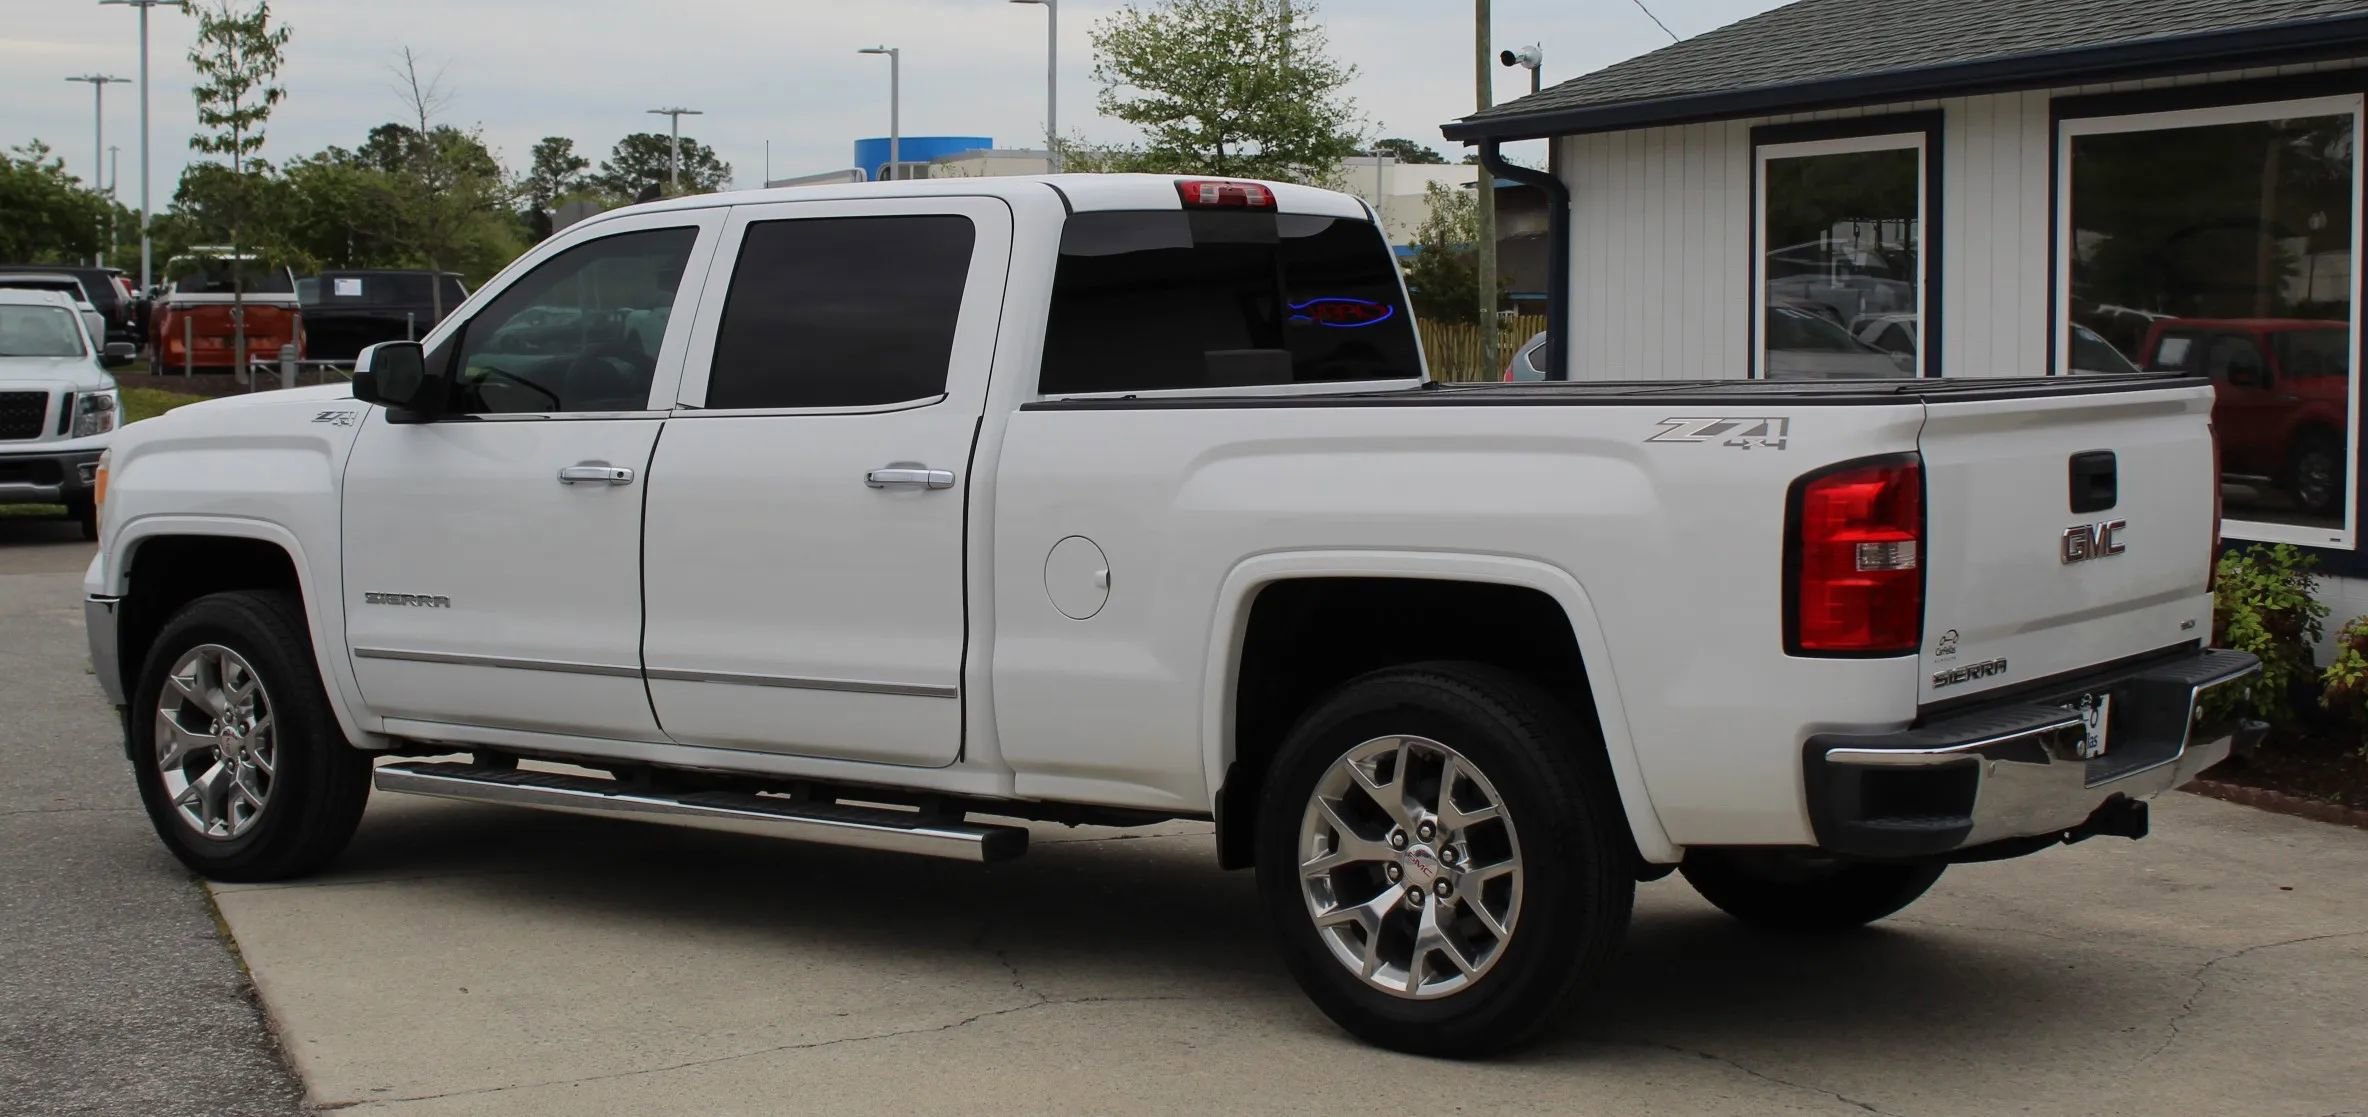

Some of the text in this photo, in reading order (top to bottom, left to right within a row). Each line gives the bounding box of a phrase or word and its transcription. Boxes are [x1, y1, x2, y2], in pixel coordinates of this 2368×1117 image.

[1643, 416, 1790, 443] Z71
[2060, 518, 2126, 565] GMC
[364, 591, 451, 608] SIERRA
[1931, 656, 2008, 689] SIERRA
[1407, 851, 1433, 878] GMC
